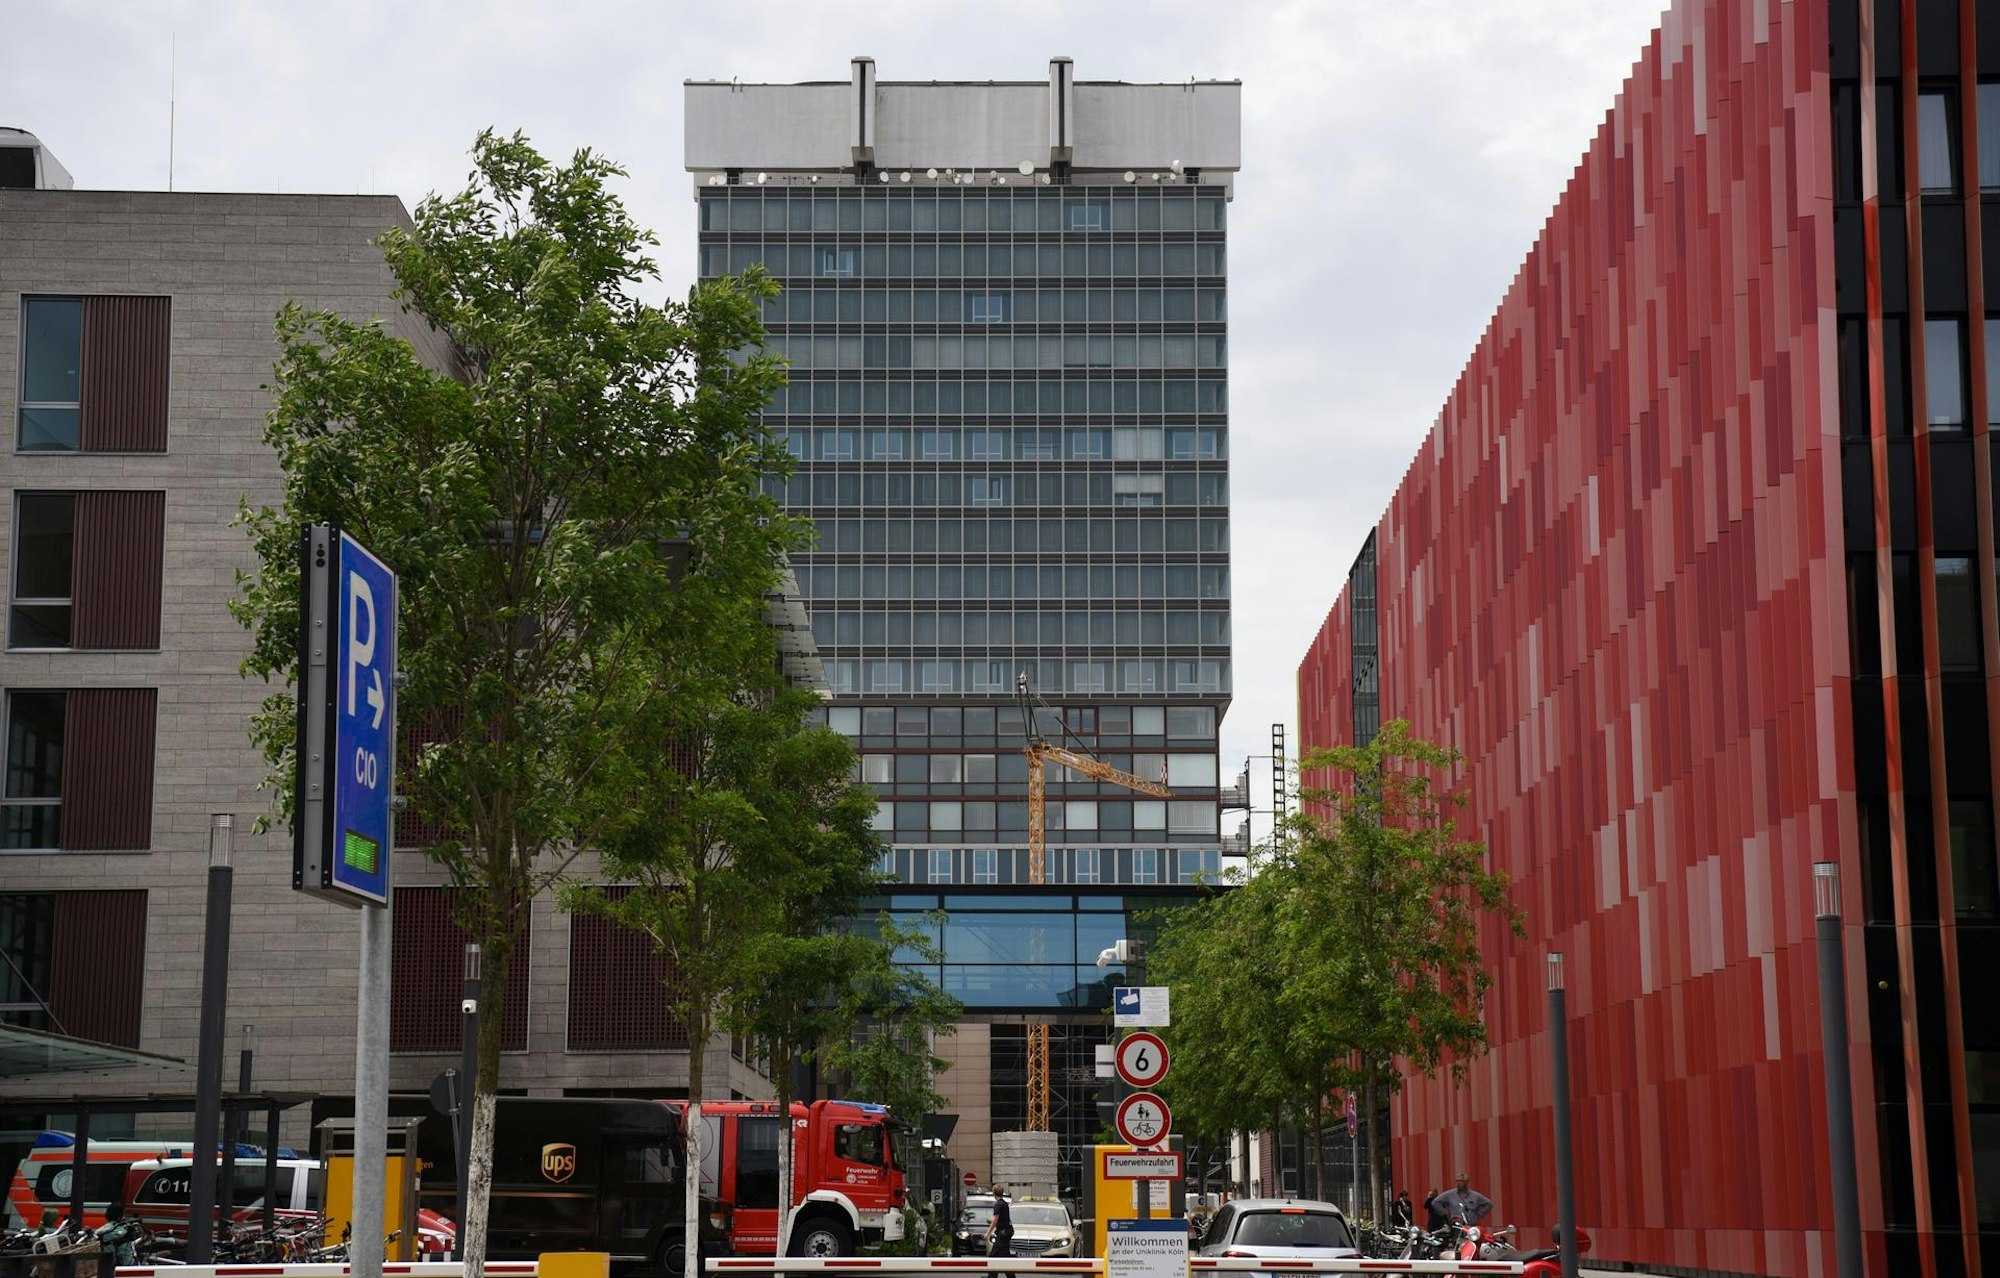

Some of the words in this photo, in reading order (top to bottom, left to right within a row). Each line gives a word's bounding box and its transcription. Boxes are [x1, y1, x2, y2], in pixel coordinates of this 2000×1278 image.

[348, 570, 376, 716] P
[355, 746, 377, 790] CIO
[1135, 1048, 1149, 1072] 6
[544, 1154, 572, 1177] ups
[1110, 1158, 1174, 1167] Feuerwehrzufahrt
[173, 1180, 192, 1193] 11
[1112, 1236, 1183, 1247] Willkommen
